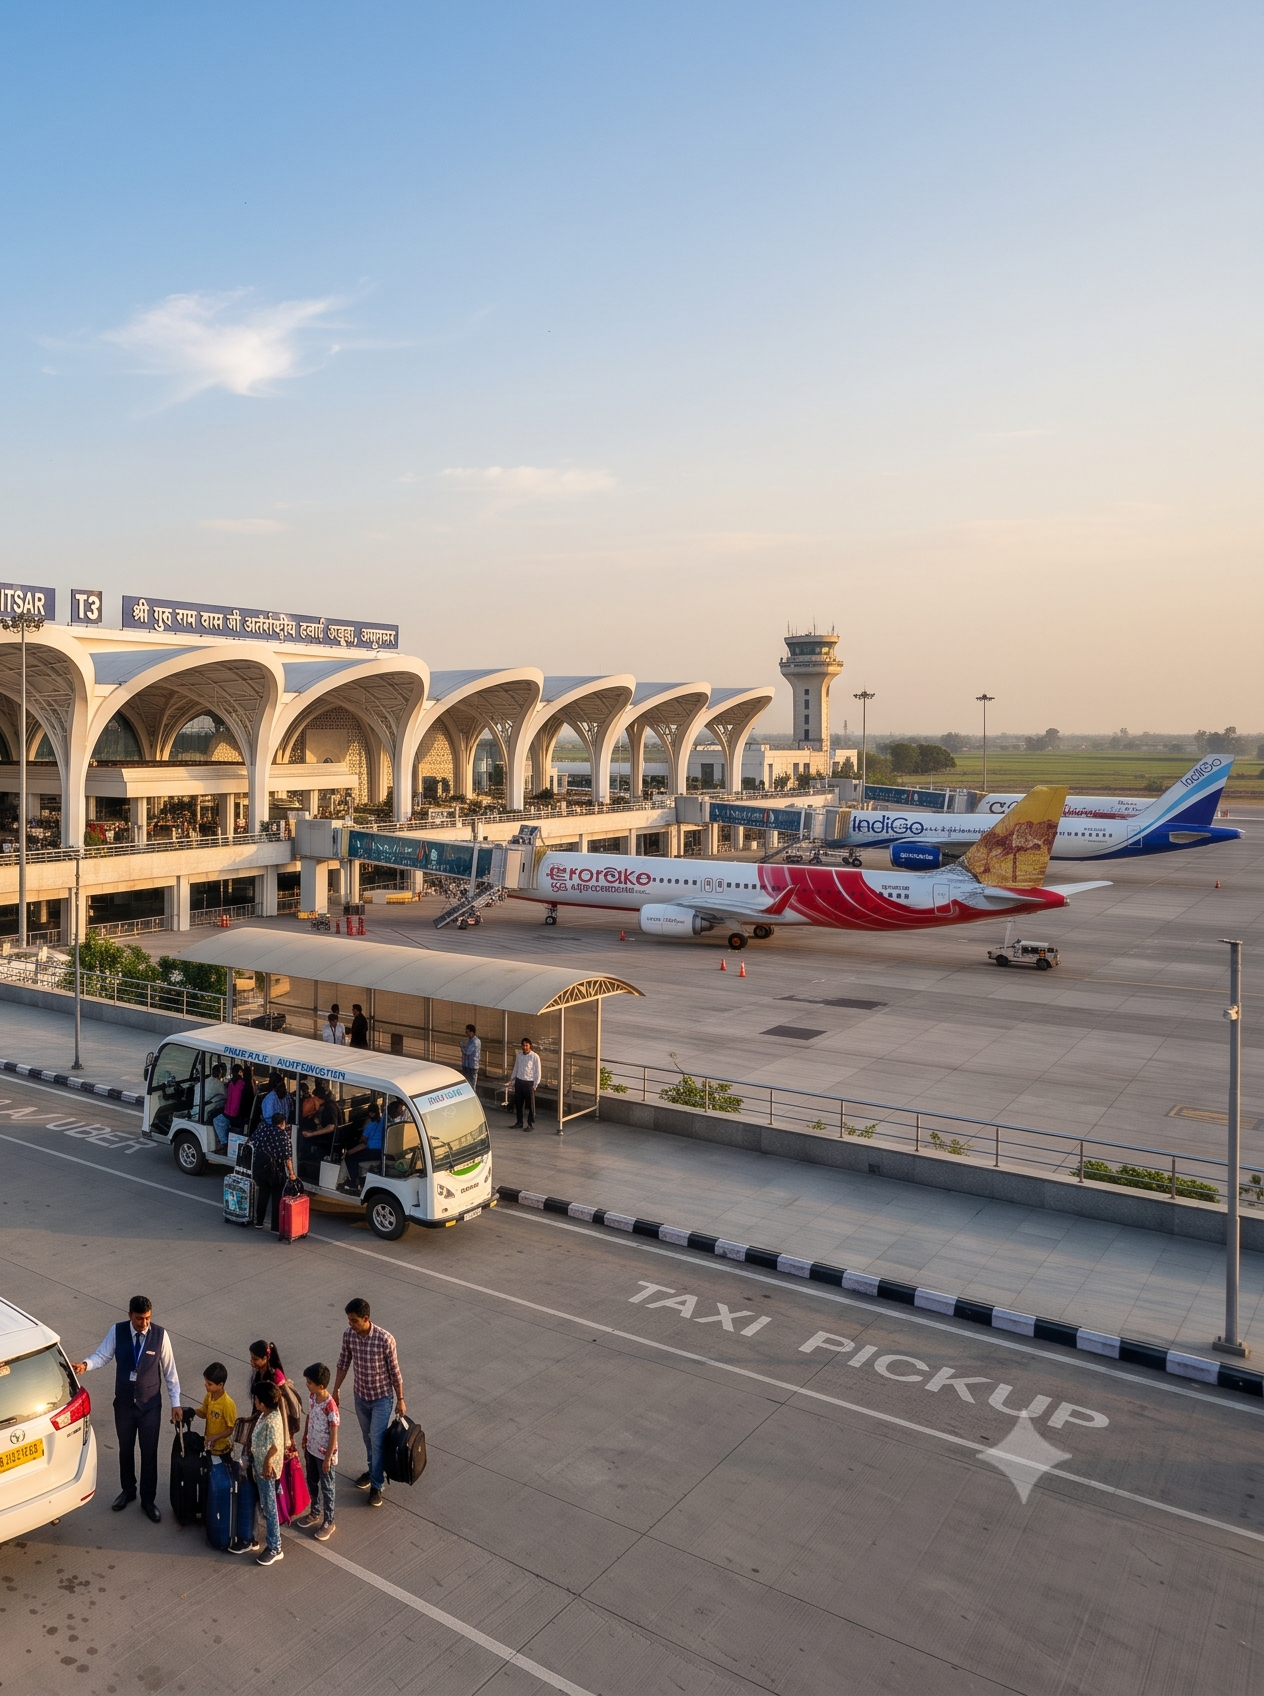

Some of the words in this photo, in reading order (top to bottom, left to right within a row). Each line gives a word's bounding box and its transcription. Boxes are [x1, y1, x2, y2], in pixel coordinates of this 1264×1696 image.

[75, 593, 101, 620] T3
[132, 598, 149, 624] श्री
[175, 608, 197, 629] राम
[226, 609, 242, 633] जी
[1179, 758, 1222, 788] IndiGo
[852, 815, 925, 835] IndiGo
[628, 1280, 772, 1338] TAXI
[797, 1330, 1110, 1431] PICKUP
